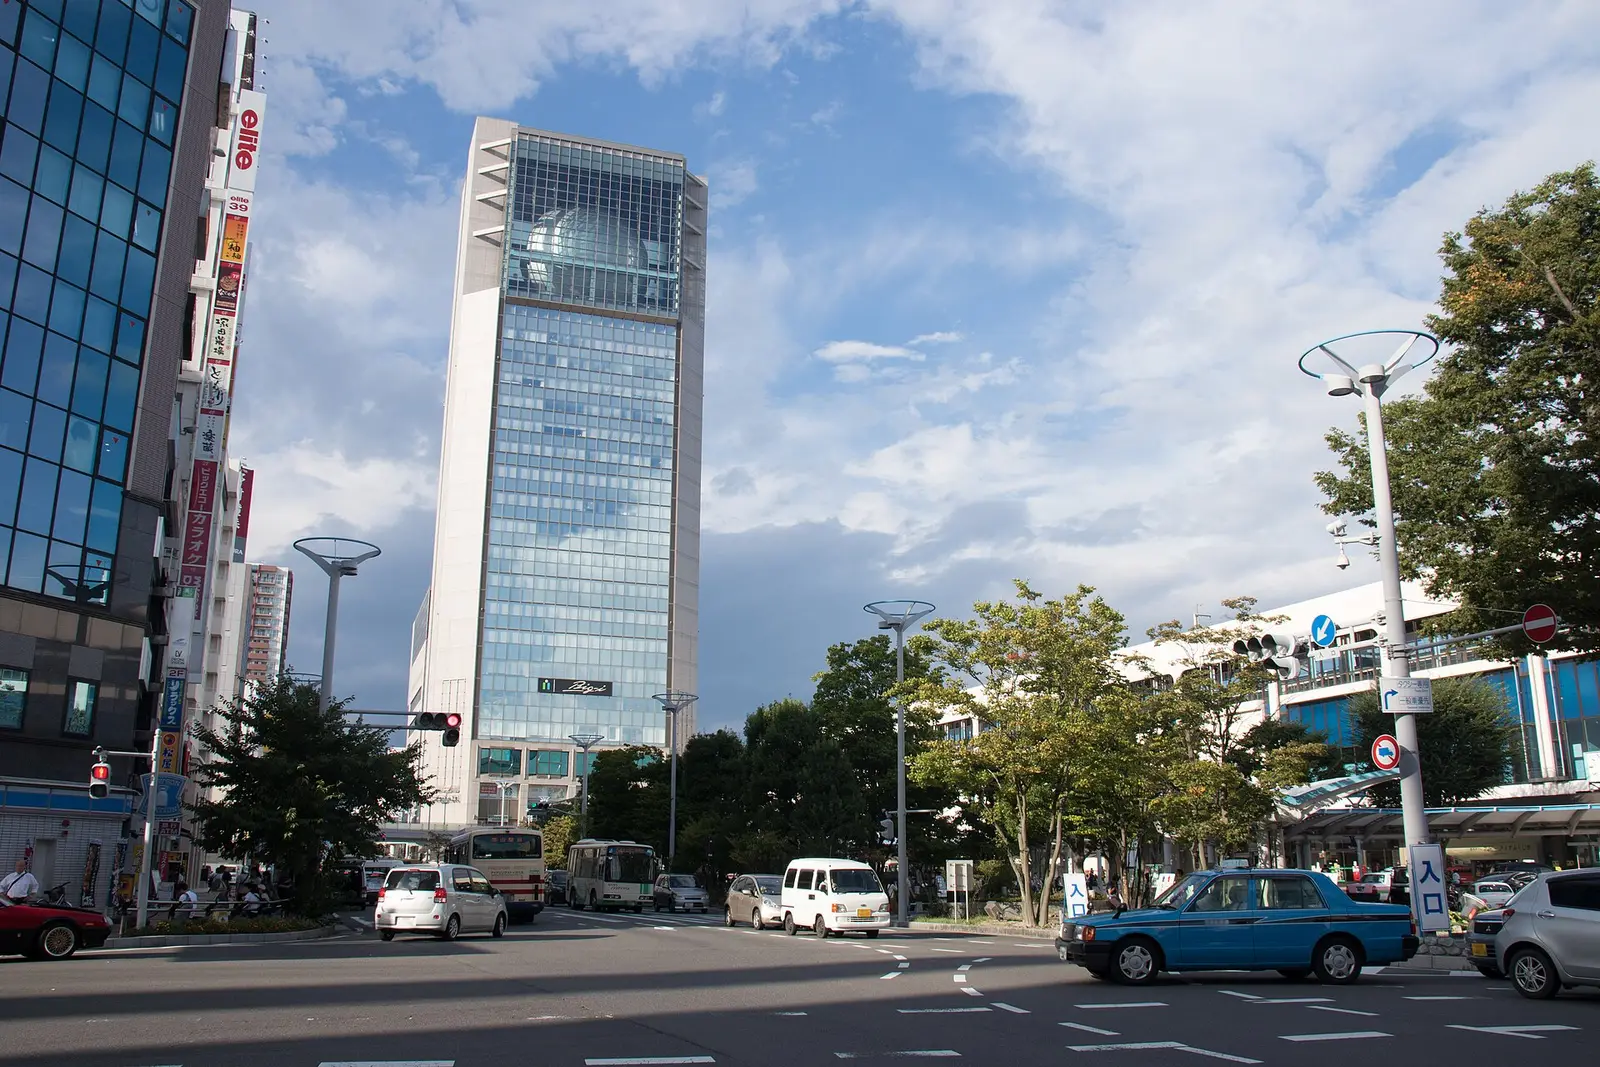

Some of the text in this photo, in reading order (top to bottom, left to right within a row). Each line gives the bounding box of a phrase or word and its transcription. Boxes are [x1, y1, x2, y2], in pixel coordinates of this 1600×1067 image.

[235, 109, 259, 170] elite
[229, 202, 248, 212] 39
[188, 513, 208, 565] カラオケ
[169, 669, 184, 677] 2F
[1070, 883, 1086, 917] 入口
[1420, 860, 1443, 914] 入口
